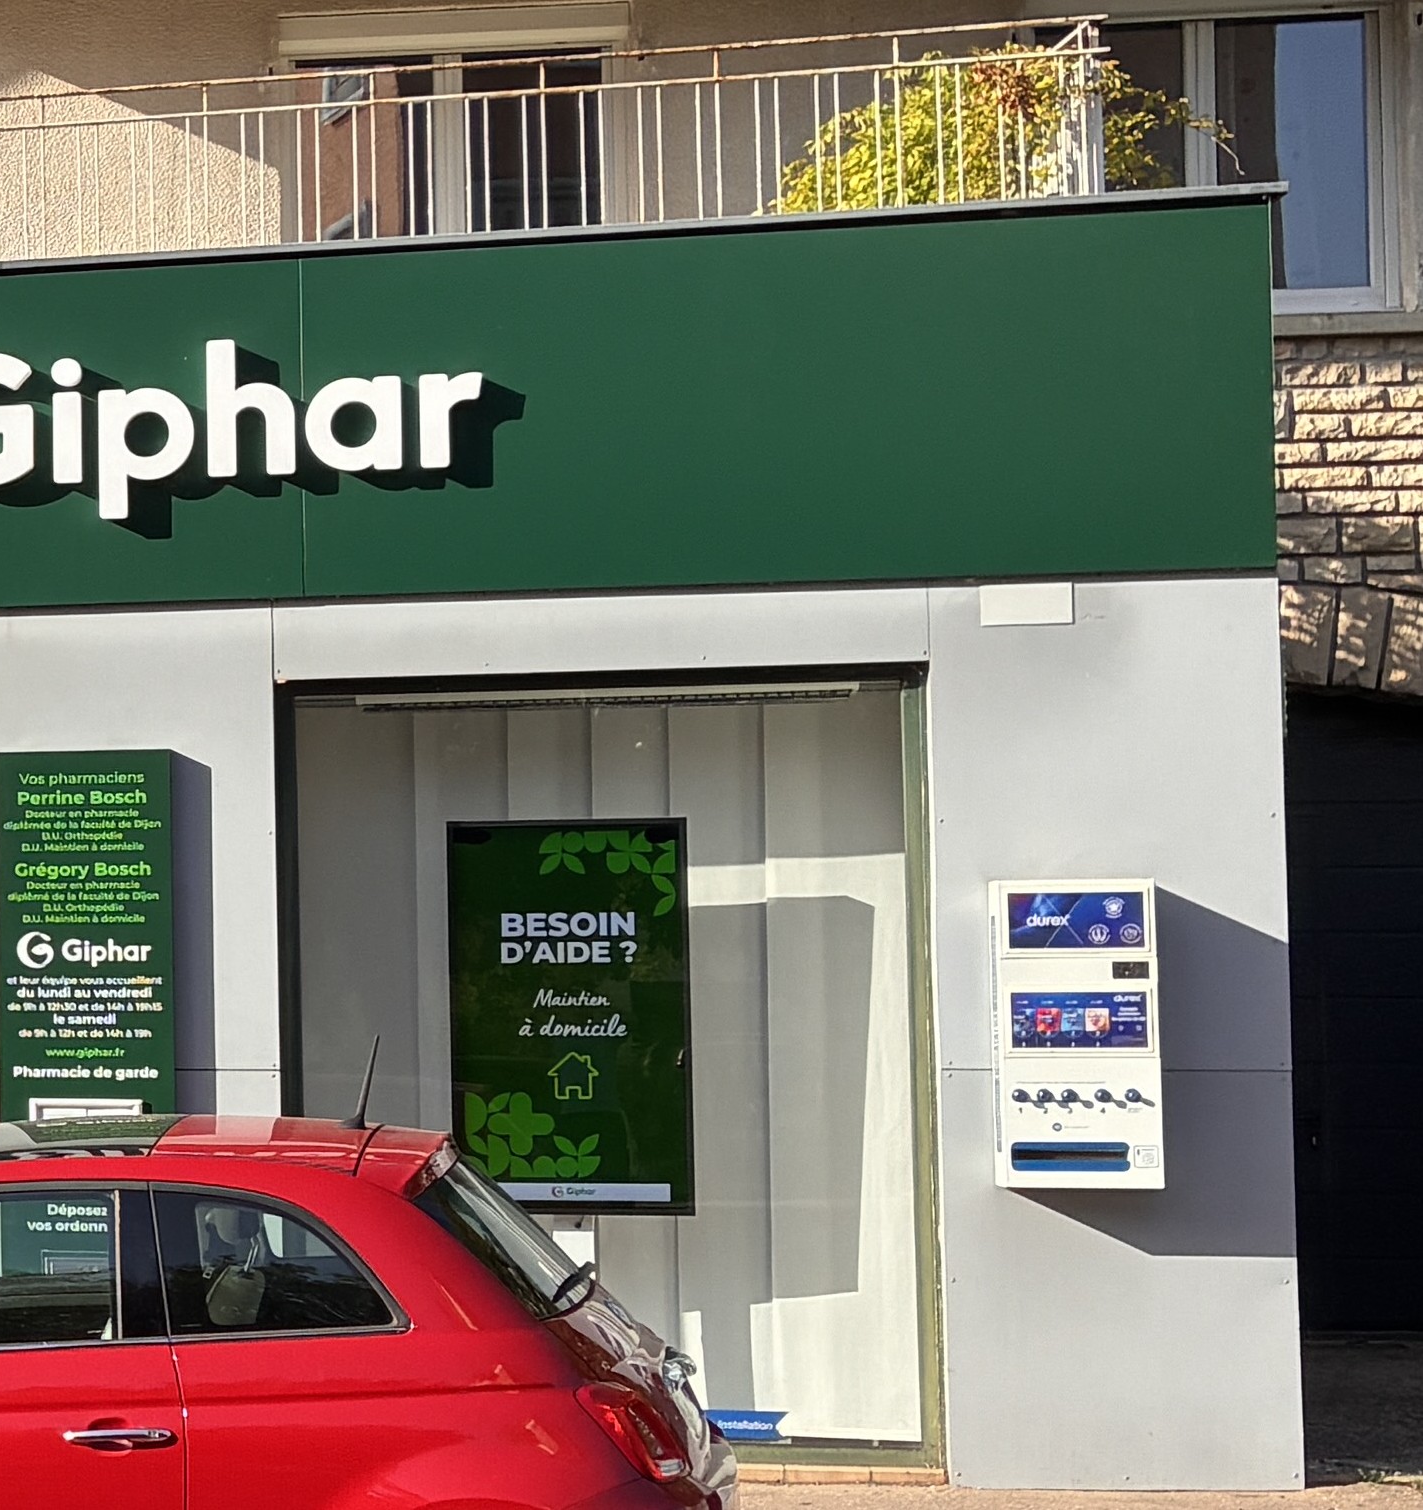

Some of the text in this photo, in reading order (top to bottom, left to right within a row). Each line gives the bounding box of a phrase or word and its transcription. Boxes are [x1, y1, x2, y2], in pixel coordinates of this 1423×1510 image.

[19, 771, 145, 787] Vos pharmaciens
[17, 789, 147, 806] Perrine Bosch
[25, 810, 67, 819] Docteur
[84, 808, 140, 820] pharmacie
[53, 820, 67, 829] de
[68, 821, 79, 829] la
[80, 819, 117, 829] faculté
[118, 819, 132, 828] de
[134, 819, 162, 830] Dijon
[42, 831, 124, 842] D.U. Orthopédie
[21, 842, 145, 852] D.U. Maintien à domicile
[14, 861, 152, 880] Grégory Bosch
[26, 881, 67, 890] Docteur
[85, 880, 140, 891] pharmacie
[51, 892, 65, 901] de
[67, 892, 77, 901] la
[78, 891, 115, 901] faculté
[116, 891, 130, 900] de
[132, 891, 160, 901] Dijon
[42, 903, 125, 913] D.U. Orthopédie
[22, 914, 146, 923] D.U. Maintien à domicile
[500, 911, 636, 938] BESOIN
[1026, 912, 1071, 927] durex
[61, 938, 152, 968] Giphar
[619, 940, 638, 964] ?
[6, 975, 162, 987] et leur équipe vous accueillent
[16, 987, 153, 998] du lundi au vendredi
[532, 988, 611, 1009] Maintien
[7, 1003, 21, 1011] de
[39, 1003, 46, 1011] à
[78, 1003, 89, 1011] et
[90, 1002, 104, 1011] de
[127, 1002, 134, 1011] à
[53, 1013, 117, 1025] le samedi
[518, 1013, 628, 1038] à domicile
[18, 1029, 32, 1038] de
[50, 1029, 57, 1038] à
[76, 1030, 88, 1038] et
[89, 1029, 103, 1038] de
[126, 1029, 133, 1038] à
[45, 1047, 125, 1059] www.giphar.fr
[13, 1064, 159, 1081] Pharmacie de garde
[27, 1221, 53, 1232] vos
